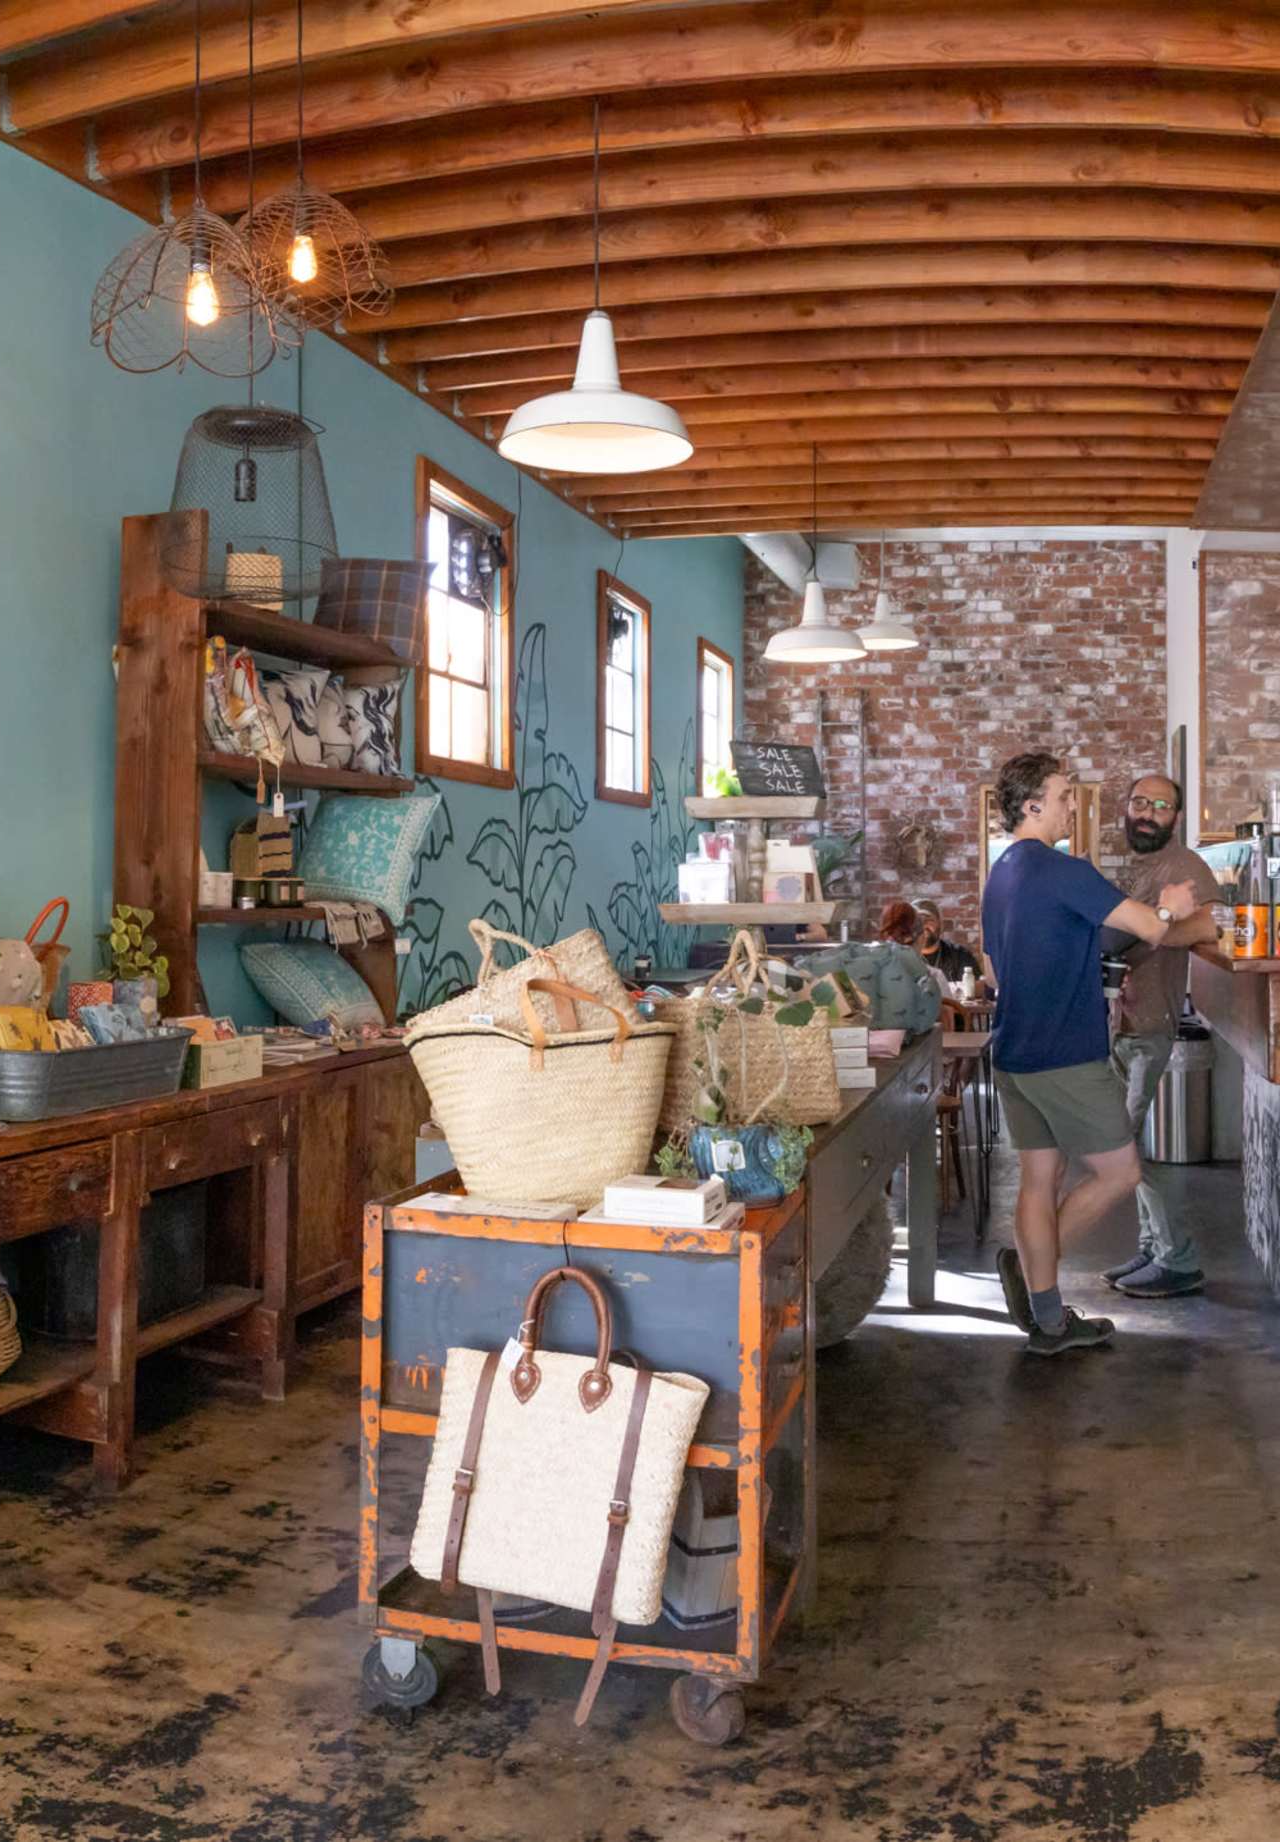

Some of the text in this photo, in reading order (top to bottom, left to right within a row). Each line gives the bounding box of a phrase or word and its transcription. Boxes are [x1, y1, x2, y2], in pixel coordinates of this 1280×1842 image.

[756, 746, 792, 762] SALE
[759, 762, 804, 778] SALE
[765, 779, 806, 794] SALE
